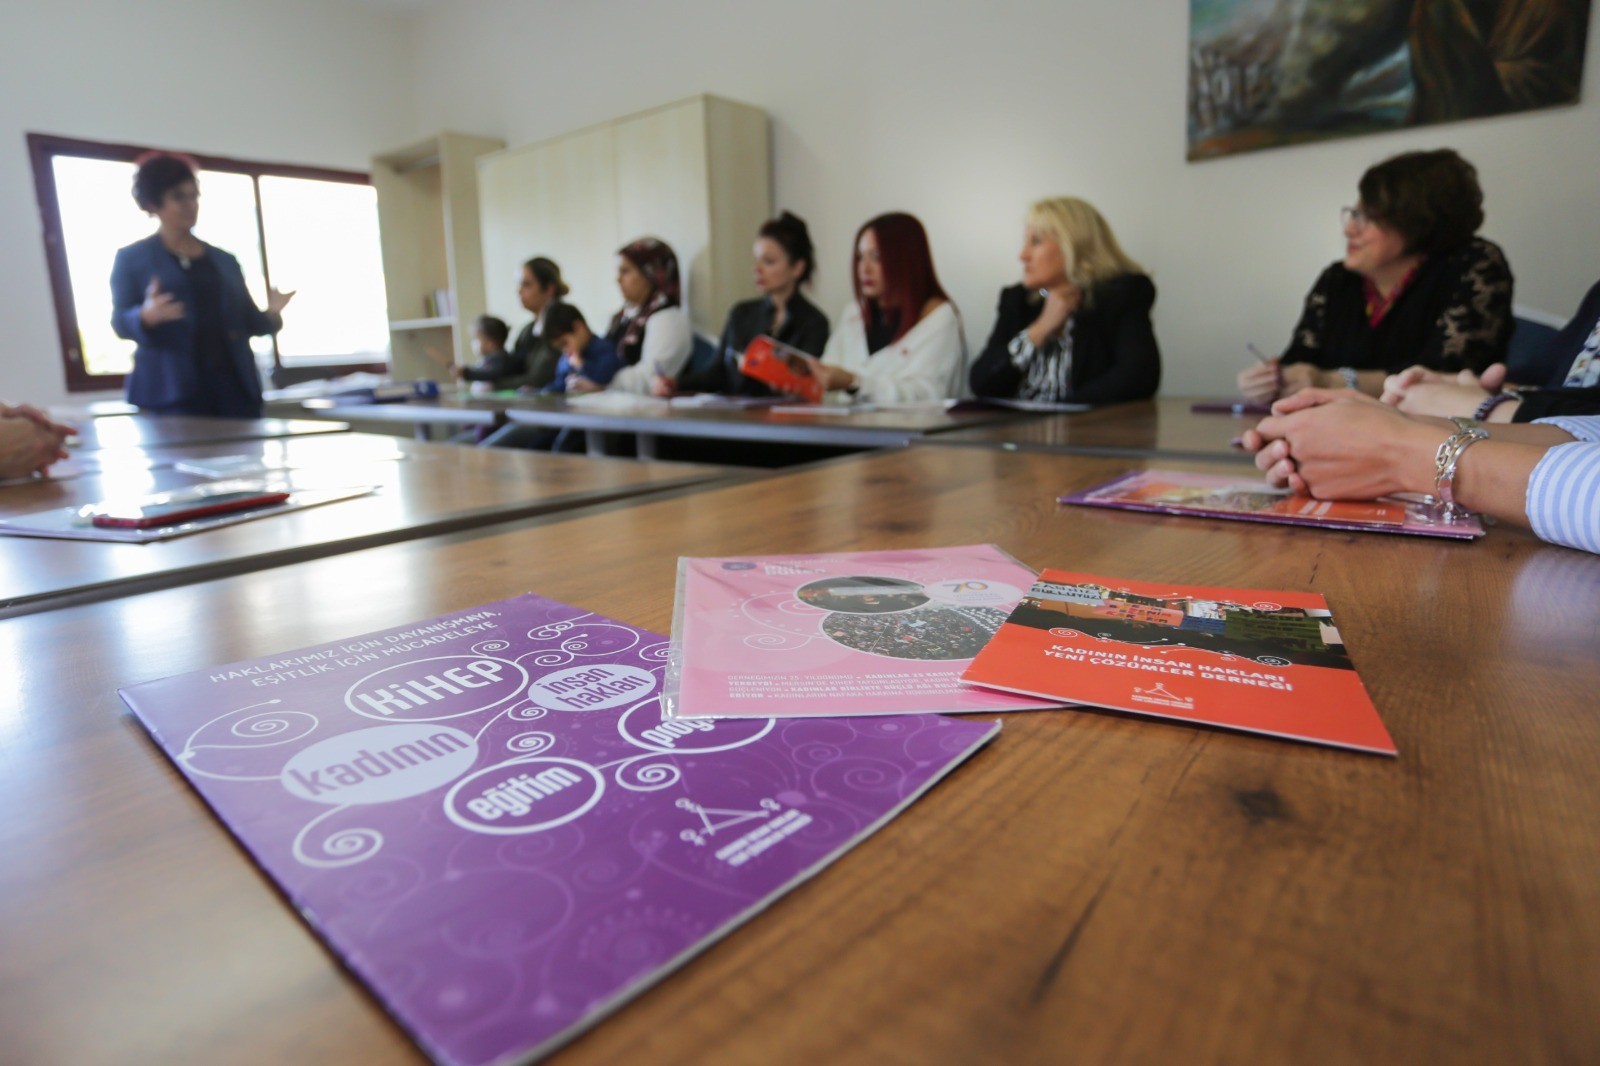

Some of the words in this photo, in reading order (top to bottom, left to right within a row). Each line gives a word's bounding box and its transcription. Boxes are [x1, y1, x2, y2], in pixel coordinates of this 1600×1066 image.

[209, 648, 336, 684] HAKLARIMIZ
[341, 638, 383, 657] İÇİN
[251, 664, 335, 688] EŞİTLİK
[338, 651, 380, 668] İÇİN
[384, 621, 499, 656] MÜCADELEYE
[1043, 649, 1085, 662] YENİ
[1089, 657, 1196, 677] ÇÖZÜMLER
[1200, 671, 1293, 692] DERNEĞİ
[1051, 643, 1127, 662] KADININ
[1132, 653, 1192, 669] İNSAN
[1197, 664, 1286, 683] HAKLARI
[535, 668, 615, 694] insan
[555, 675, 651, 709] hakları
[287, 732, 471, 797] kadının
[466, 767, 583, 821] eğitim
